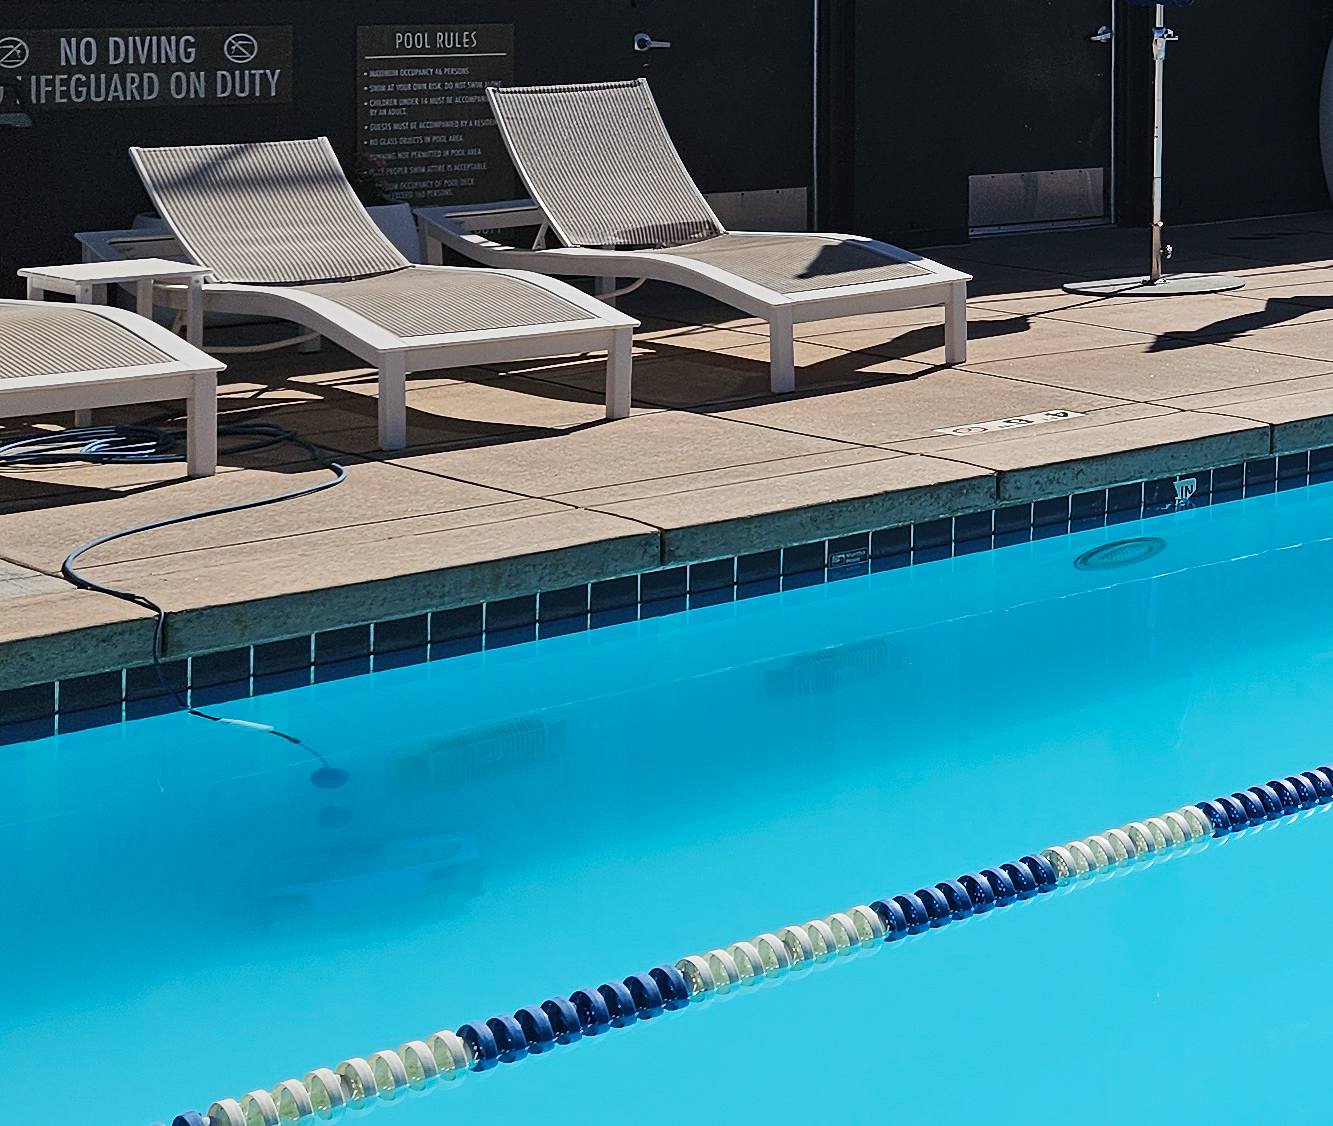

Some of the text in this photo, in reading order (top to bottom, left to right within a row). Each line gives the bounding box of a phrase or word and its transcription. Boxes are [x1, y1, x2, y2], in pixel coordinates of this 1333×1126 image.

[60, 36, 195, 66] NO DIVING
[396, 31, 477, 49] POOL RULES
[17, 72, 159, 105] IFEGUARD
[170, 72, 206, 100] ON
[216, 70, 281, 98] DUTY
[1181, 484, 1194, 498] IN
